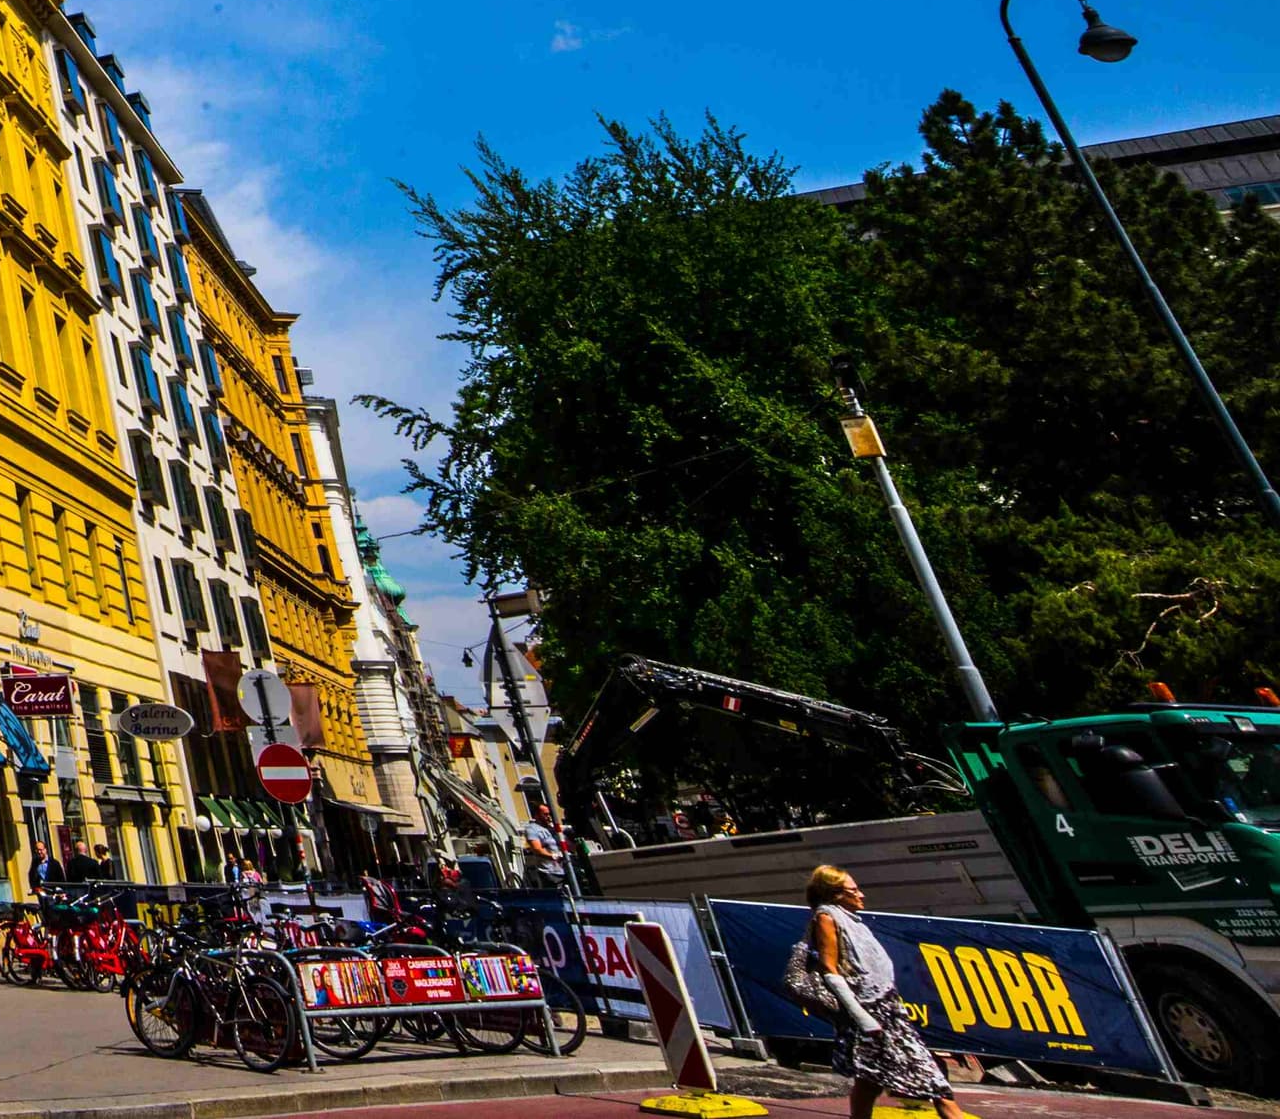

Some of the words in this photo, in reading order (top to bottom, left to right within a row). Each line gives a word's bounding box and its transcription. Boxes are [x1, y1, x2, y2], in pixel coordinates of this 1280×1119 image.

[11, 682, 65, 704] Carat
[130, 706, 178, 722] Galerie
[131, 723, 178, 735] Barina
[1055, 813, 1075, 838] 4
[1134, 831, 1224, 854] DELI
[1139, 852, 1241, 866] TRANSPORTE
[407, 960, 437, 969] CASHMERE
[441, 959, 454, 968] SILK
[580, 932, 640, 979] BA
[414, 977, 453, 987] NAGLERGASSE
[918, 942, 1087, 1037] PORR
